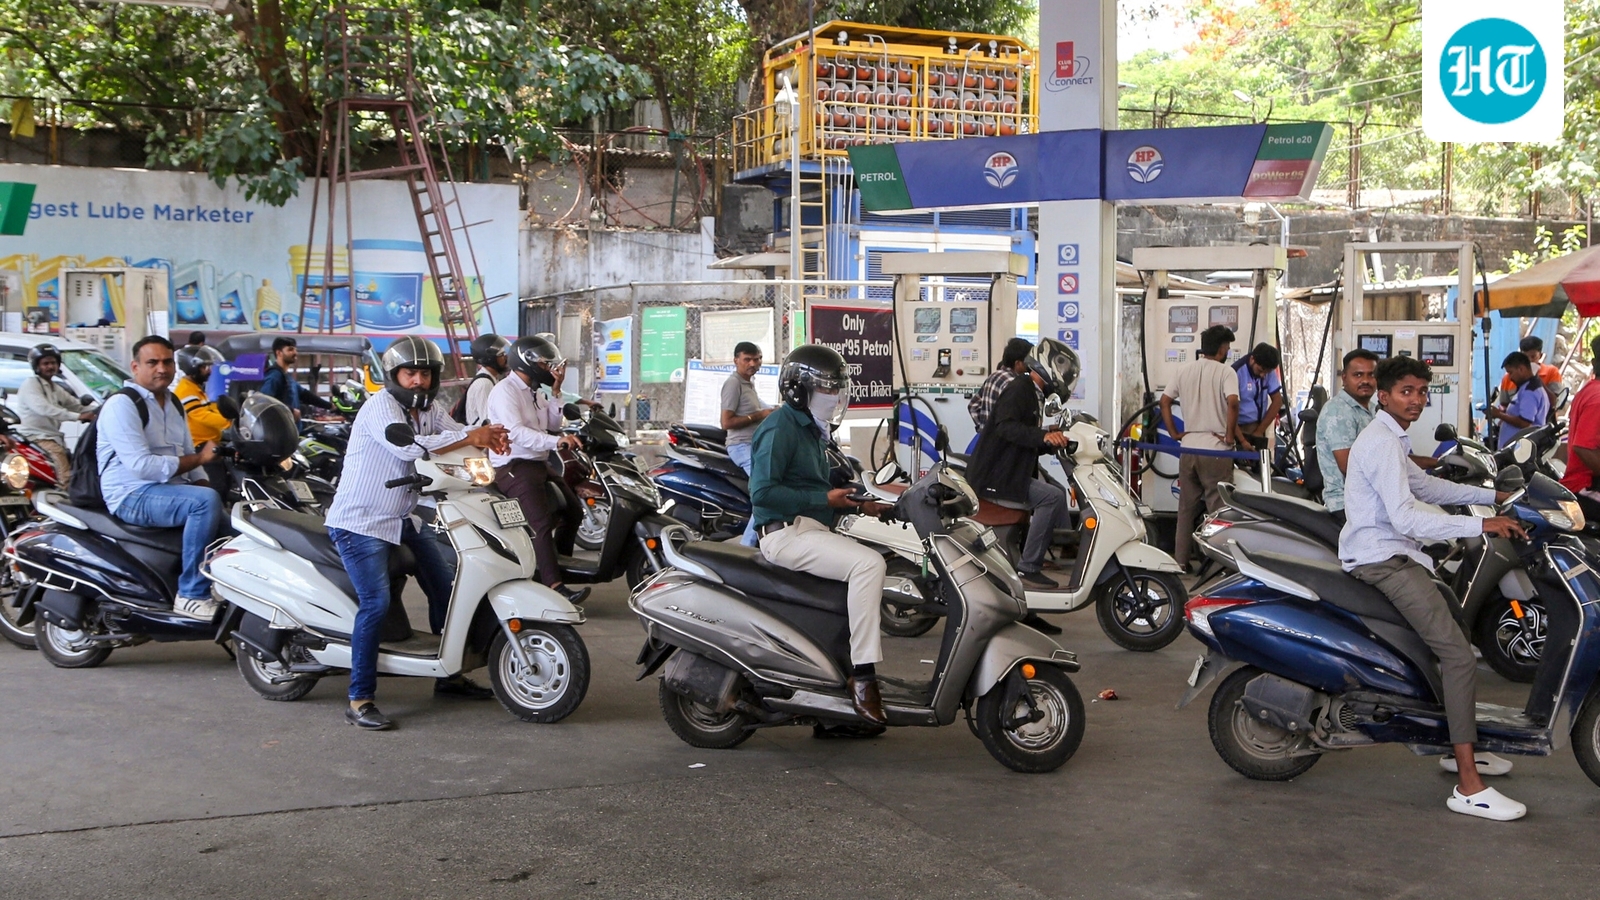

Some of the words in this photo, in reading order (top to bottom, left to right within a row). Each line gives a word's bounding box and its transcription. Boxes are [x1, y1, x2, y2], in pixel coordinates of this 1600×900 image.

[1268, 136, 1294, 145] Petrol
[1296, 135, 1313, 145] e20
[991, 156, 1011, 168] HP
[1135, 151, 1155, 163] HP
[860, 172, 897, 182] PETROL
[87, 201, 145, 220] Lube
[153, 204, 254, 224] Marketer
[842, 313, 865, 335] Only
[815, 338, 860, 356] er'95
[862, 339, 892, 356] Petrol
